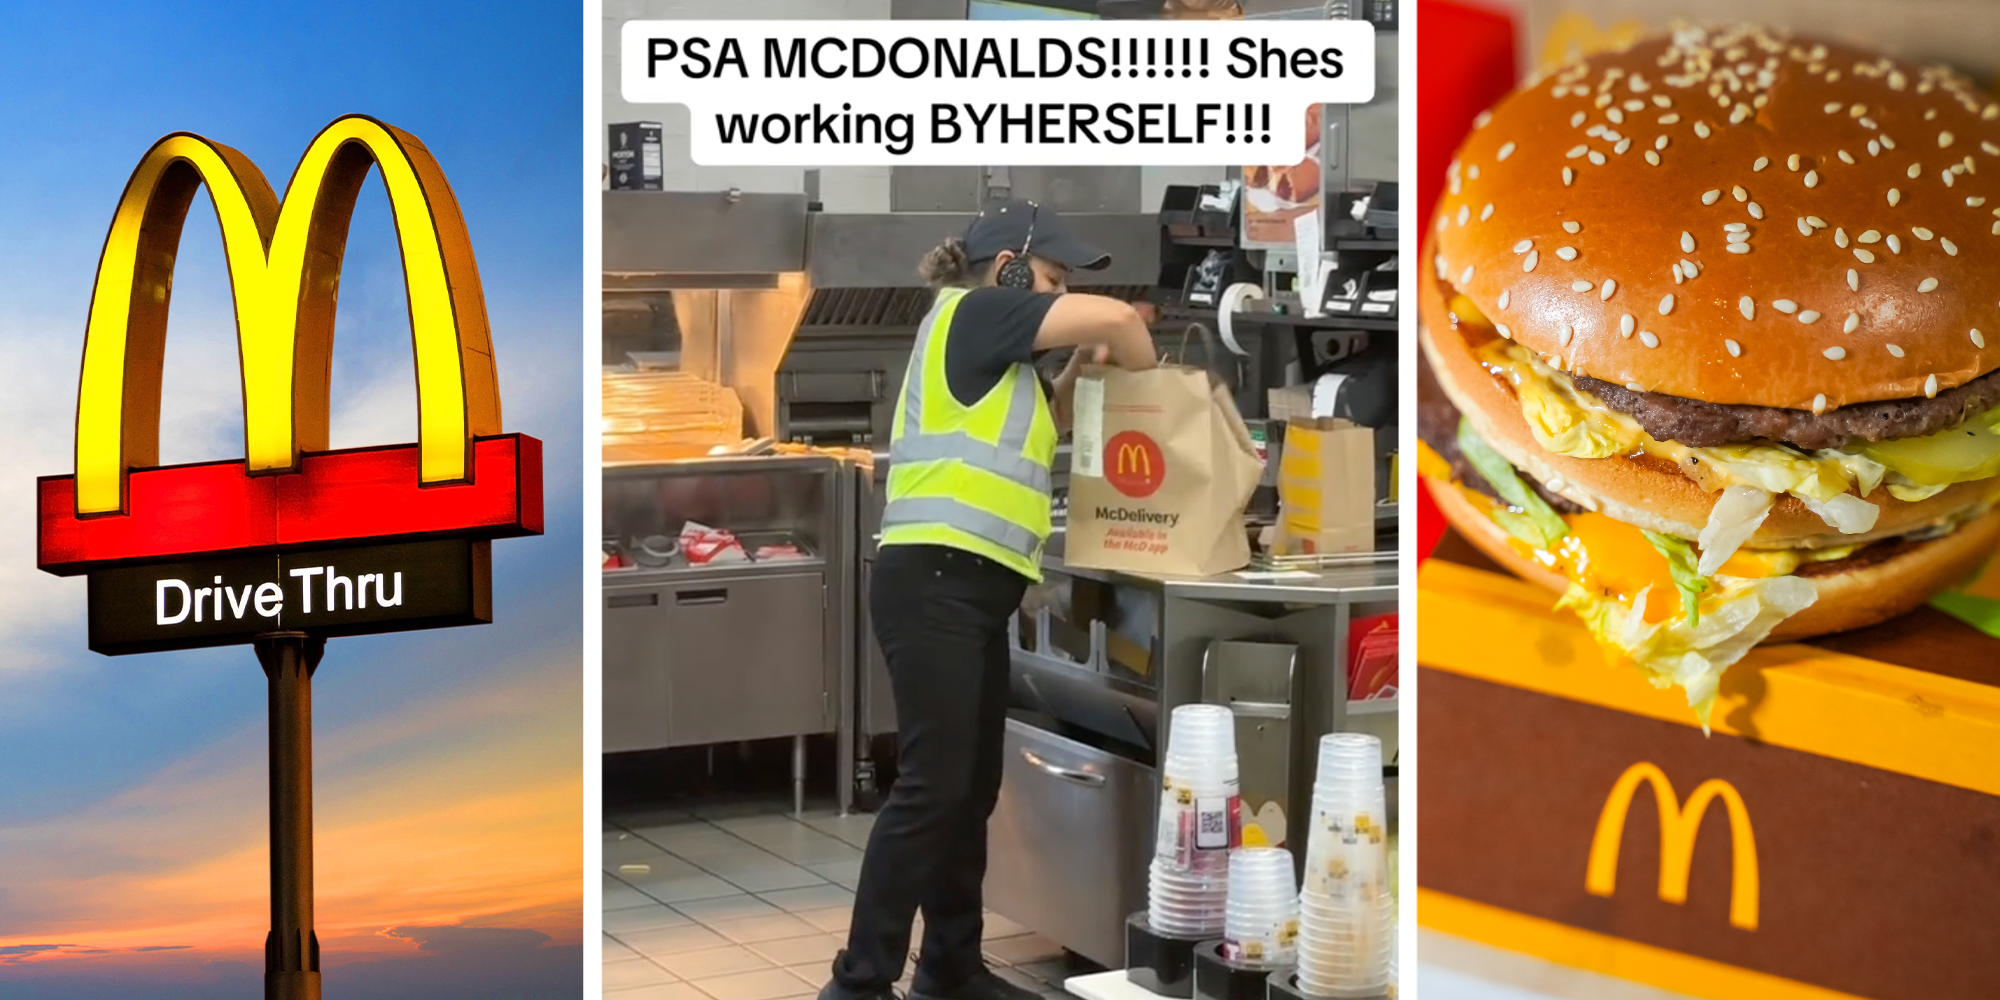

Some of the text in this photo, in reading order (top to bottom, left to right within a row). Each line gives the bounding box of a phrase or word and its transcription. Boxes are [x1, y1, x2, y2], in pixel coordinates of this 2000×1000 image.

[74, 113, 475, 518] M
[1117, 443, 1151, 476] M
[1094, 506, 1180, 528] McDelivery
[1105, 527, 1167, 540] Available in
[1103, 539, 1168, 555] the McD app
[156, 565, 403, 626] Drive Thru
[1585, 761, 1760, 931] M
